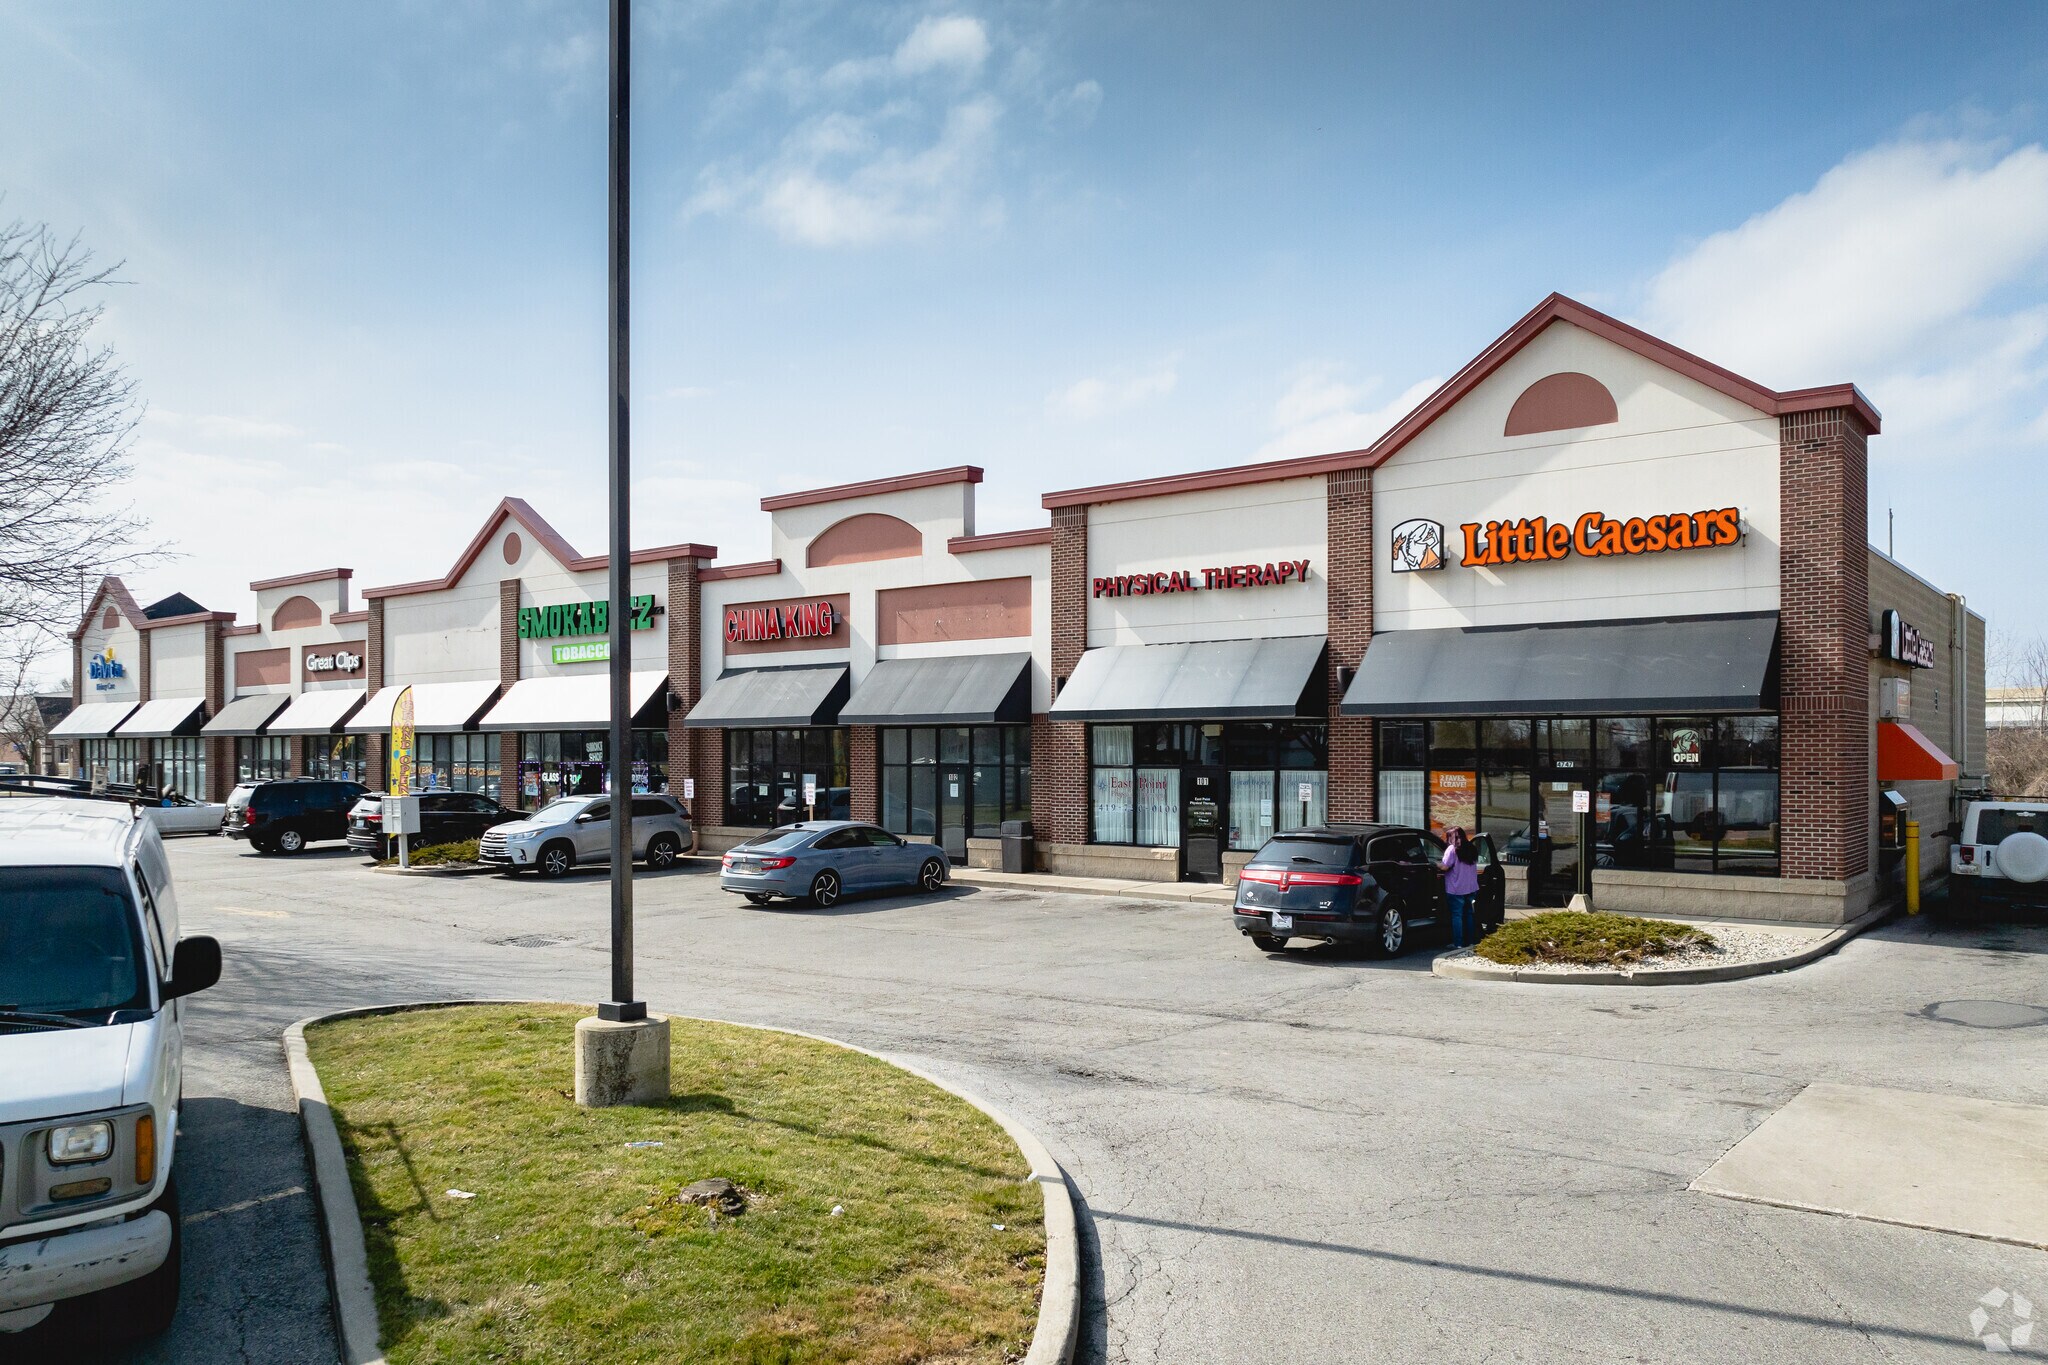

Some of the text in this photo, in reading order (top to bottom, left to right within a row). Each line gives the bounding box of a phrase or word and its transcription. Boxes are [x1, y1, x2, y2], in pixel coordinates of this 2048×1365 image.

[1460, 507, 1742, 567] Little Caesars
[1093, 559, 1310, 598] PHYSICAL THERAPY
[518, 594, 655, 638] SMOKABZ
[725, 601, 833, 643] CHINA KING
[90, 654, 123, 679] DaVita
[306, 651, 360, 673] Great Clips
[1673, 753, 1699, 763] OPEN
[397, 755, 411, 796] OPEN
[453, 767, 477, 776] CHOCE
[541, 772, 560, 783] GLASS
[1111, 776, 1168, 790] East Point
